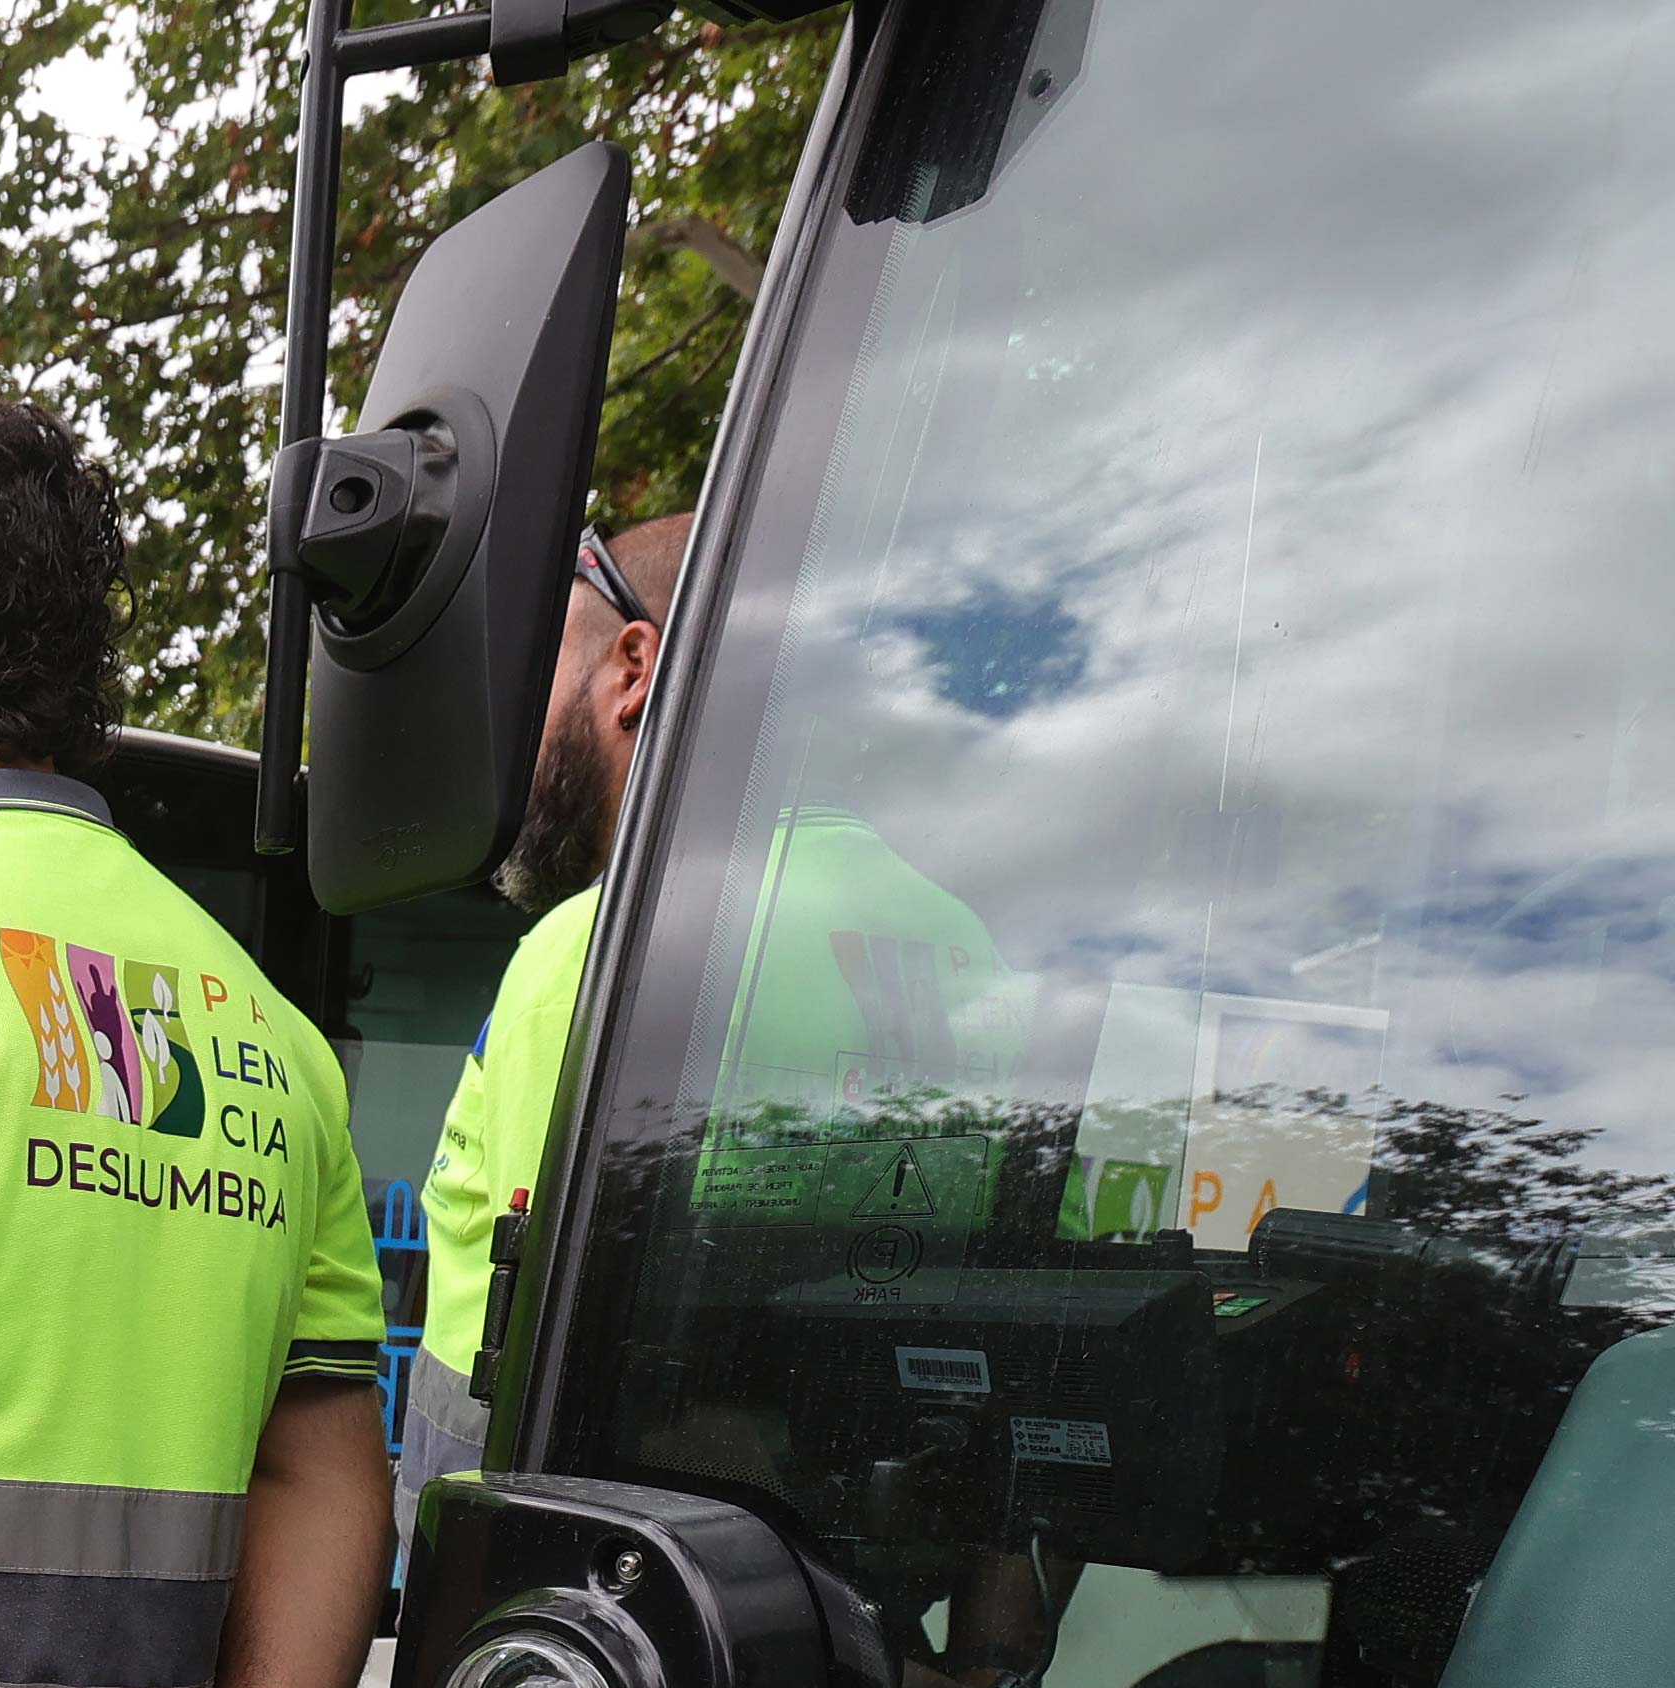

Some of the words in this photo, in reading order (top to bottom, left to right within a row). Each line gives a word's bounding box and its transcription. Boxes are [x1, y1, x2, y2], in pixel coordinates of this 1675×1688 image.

[211, 1036, 290, 1096] LEN
[220, 1104, 289, 1163] CIA
[27, 1137, 287, 1235] DESLUMBRA
